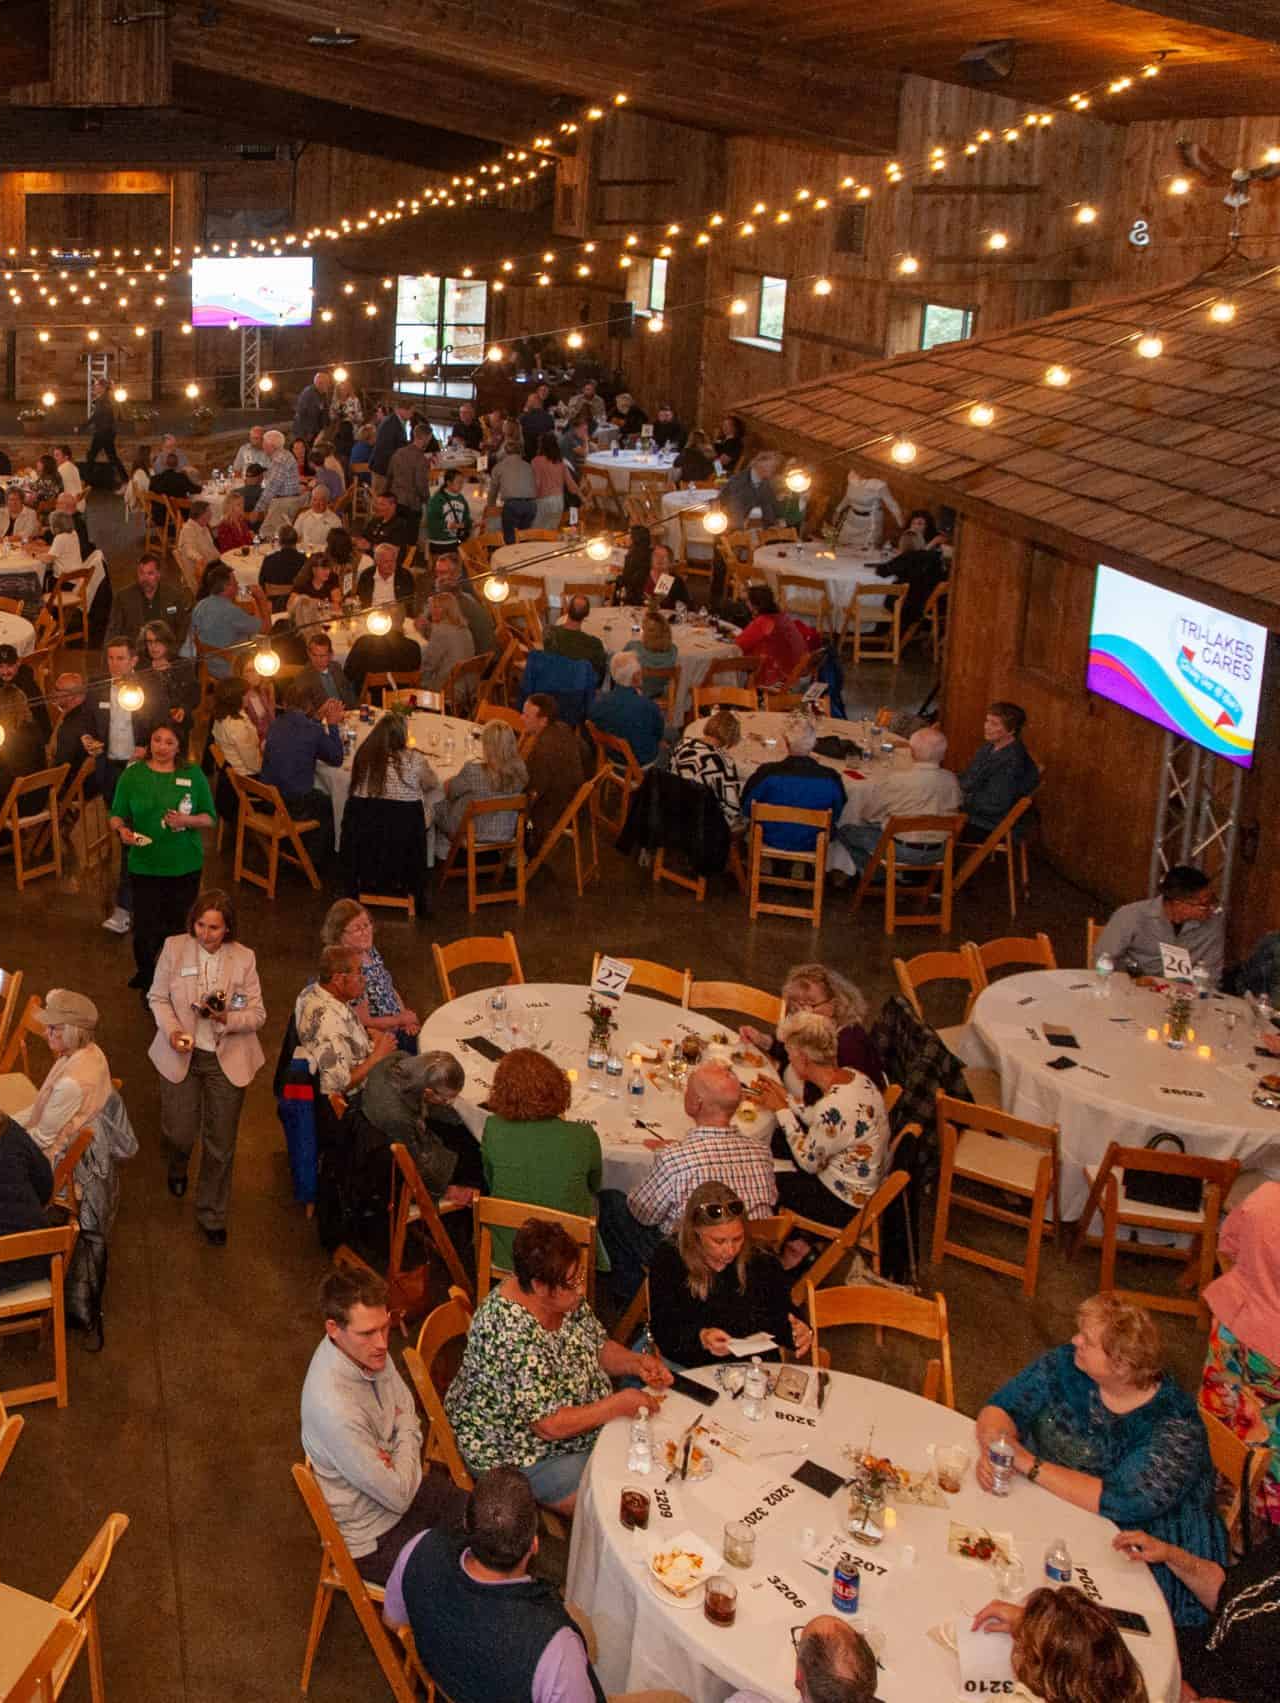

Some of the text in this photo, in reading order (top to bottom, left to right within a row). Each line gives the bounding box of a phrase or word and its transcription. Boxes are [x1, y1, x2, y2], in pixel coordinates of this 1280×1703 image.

[1180, 617, 1255, 662] TRI-LAKES
[1201, 646, 1252, 682] CARES
[1165, 955, 1191, 977] 26
[596, 967, 628, 990] 27
[774, 1410, 817, 1428] 3208
[653, 1487, 674, 1519] 3209
[761, 1484, 796, 1507] 3202
[738, 1506, 770, 1528] 320
[839, 1550, 889, 1577] 3207
[766, 1574, 808, 1610] 3206
[964, 1679, 1015, 1694] 3210
